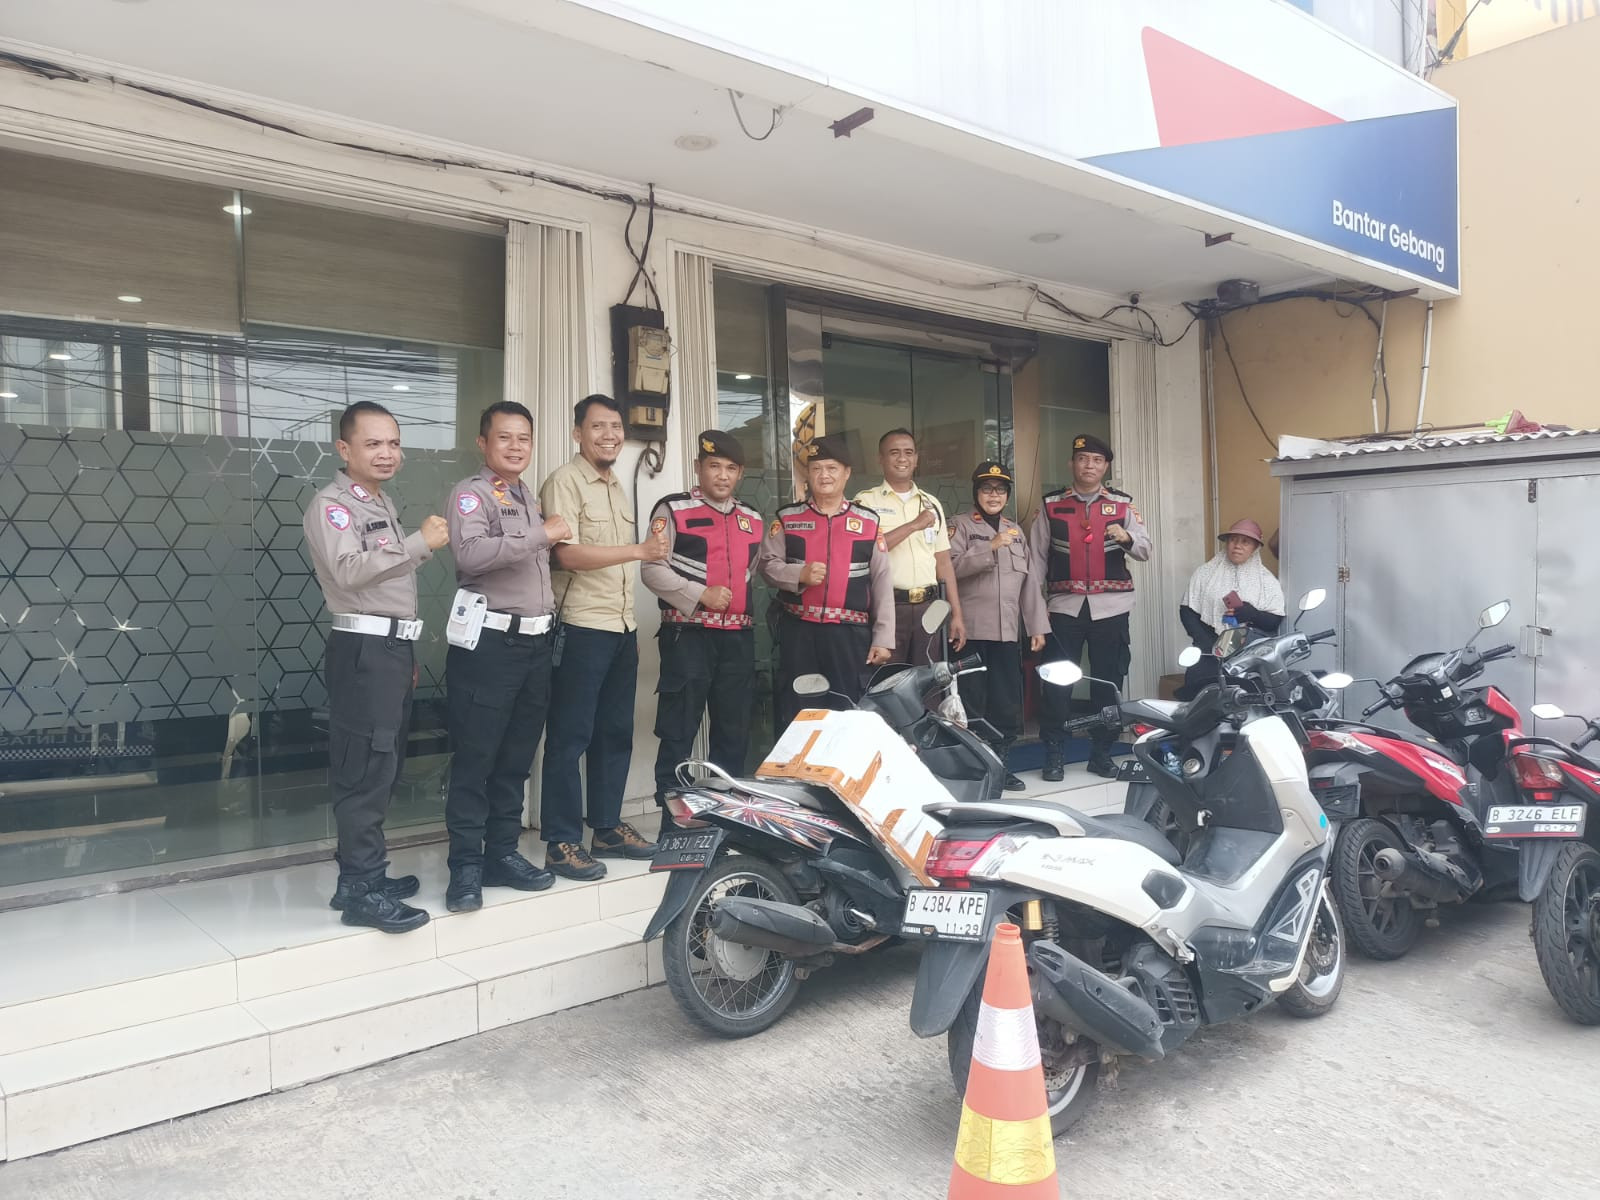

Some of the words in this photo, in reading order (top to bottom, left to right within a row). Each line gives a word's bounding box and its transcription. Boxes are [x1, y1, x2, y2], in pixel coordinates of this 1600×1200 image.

[1332, 200, 1387, 242] Bantar
[1389, 223, 1445, 273] Gebang
[1492, 809, 1500, 821] B
[1508, 808, 1543, 821] 3246
[1552, 808, 1579, 820] ELF
[909, 895, 917, 912] B
[922, 895, 953, 913] 4384
[958, 896, 985, 916] KPE
